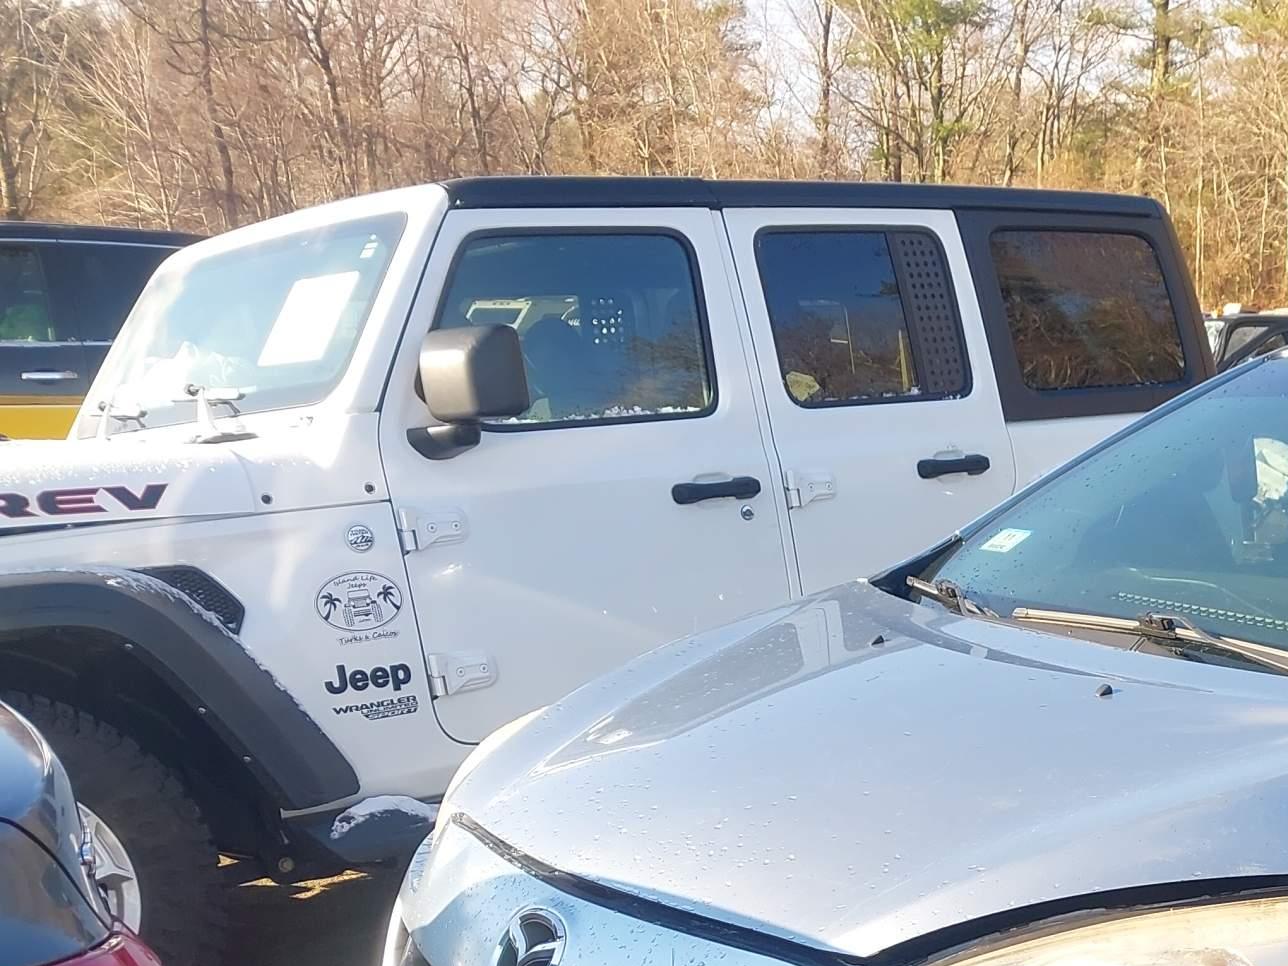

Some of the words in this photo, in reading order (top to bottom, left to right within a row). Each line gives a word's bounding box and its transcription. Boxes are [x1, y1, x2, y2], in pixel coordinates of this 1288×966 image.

[339, 634, 362, 645] Turks
[325, 663, 412, 694] Jeep
[332, 695, 417, 715] WRANGLER
[361, 701, 418, 715] UNLIMITED
[367, 707, 417, 719] SPORT
